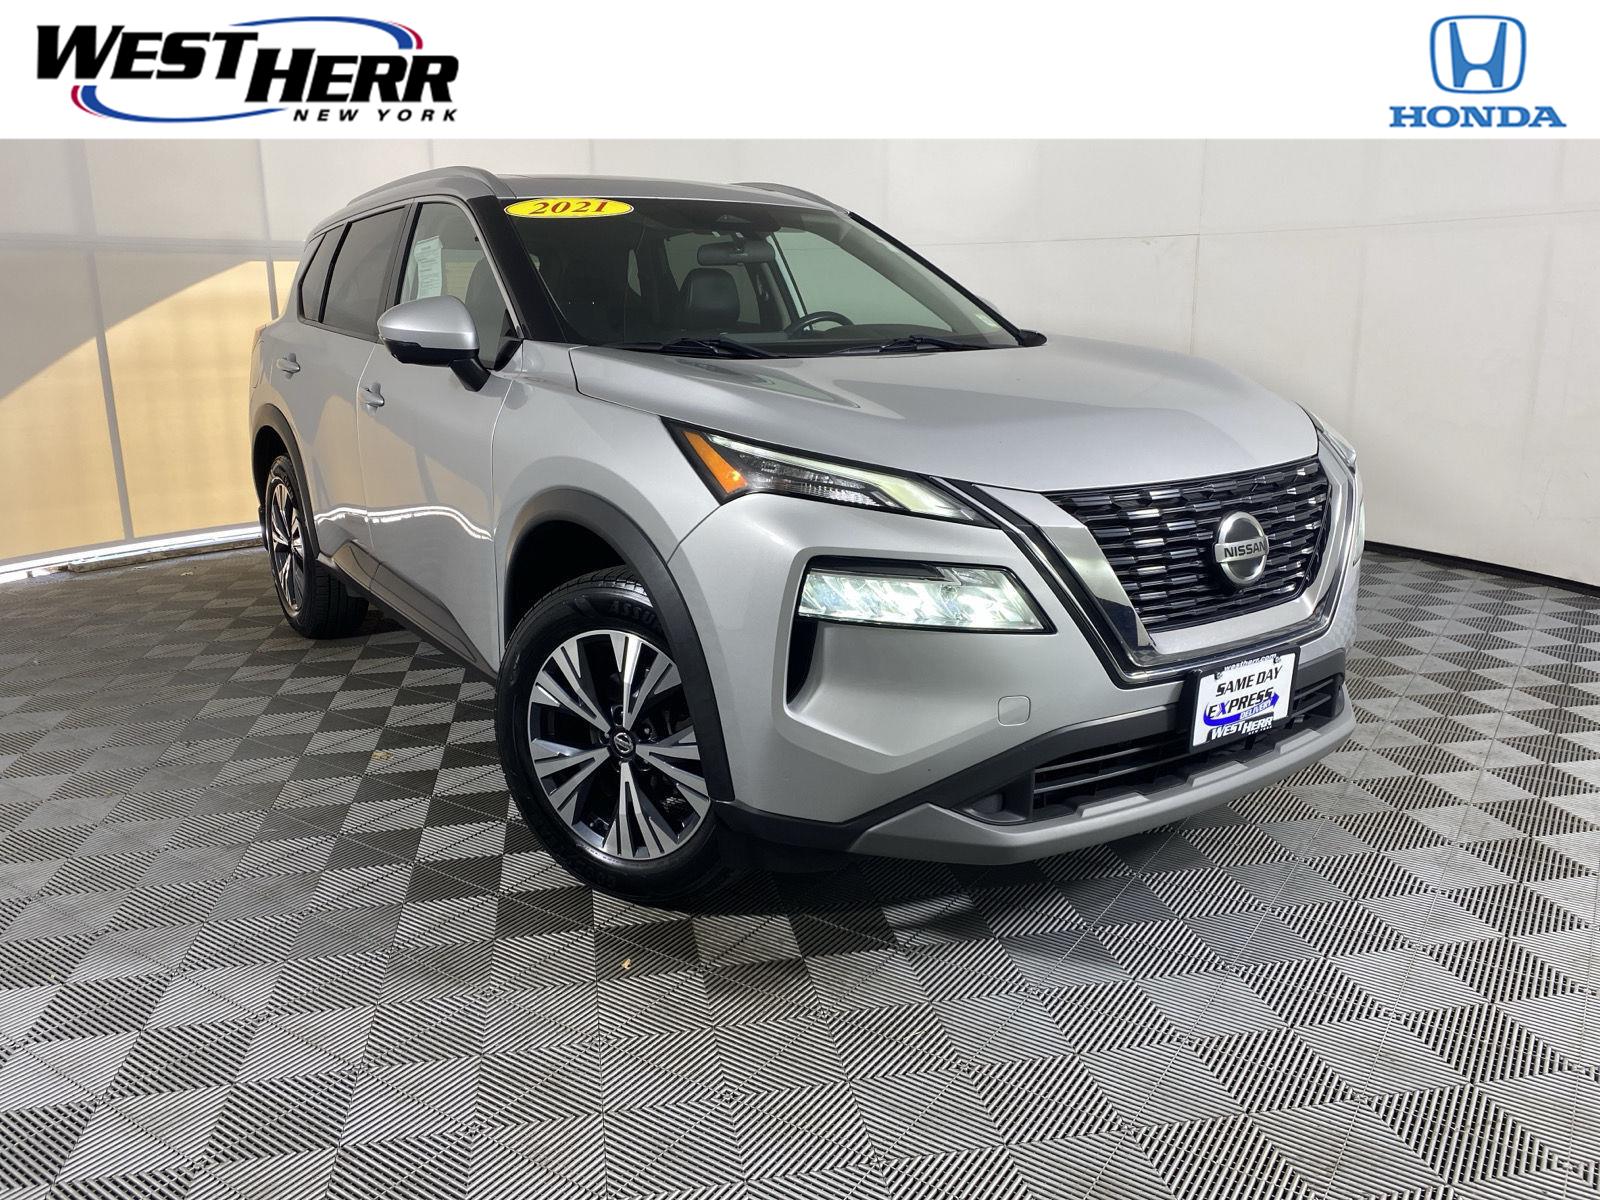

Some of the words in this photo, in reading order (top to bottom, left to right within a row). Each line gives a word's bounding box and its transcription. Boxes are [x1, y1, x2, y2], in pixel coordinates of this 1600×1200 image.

[528, 201, 608, 214] 2021
[1223, 541, 1266, 558] NISSAN
[1216, 674, 1255, 697] SAME
[1256, 665, 1282, 685] DAY
[1208, 687, 1274, 718] EXPRESS
